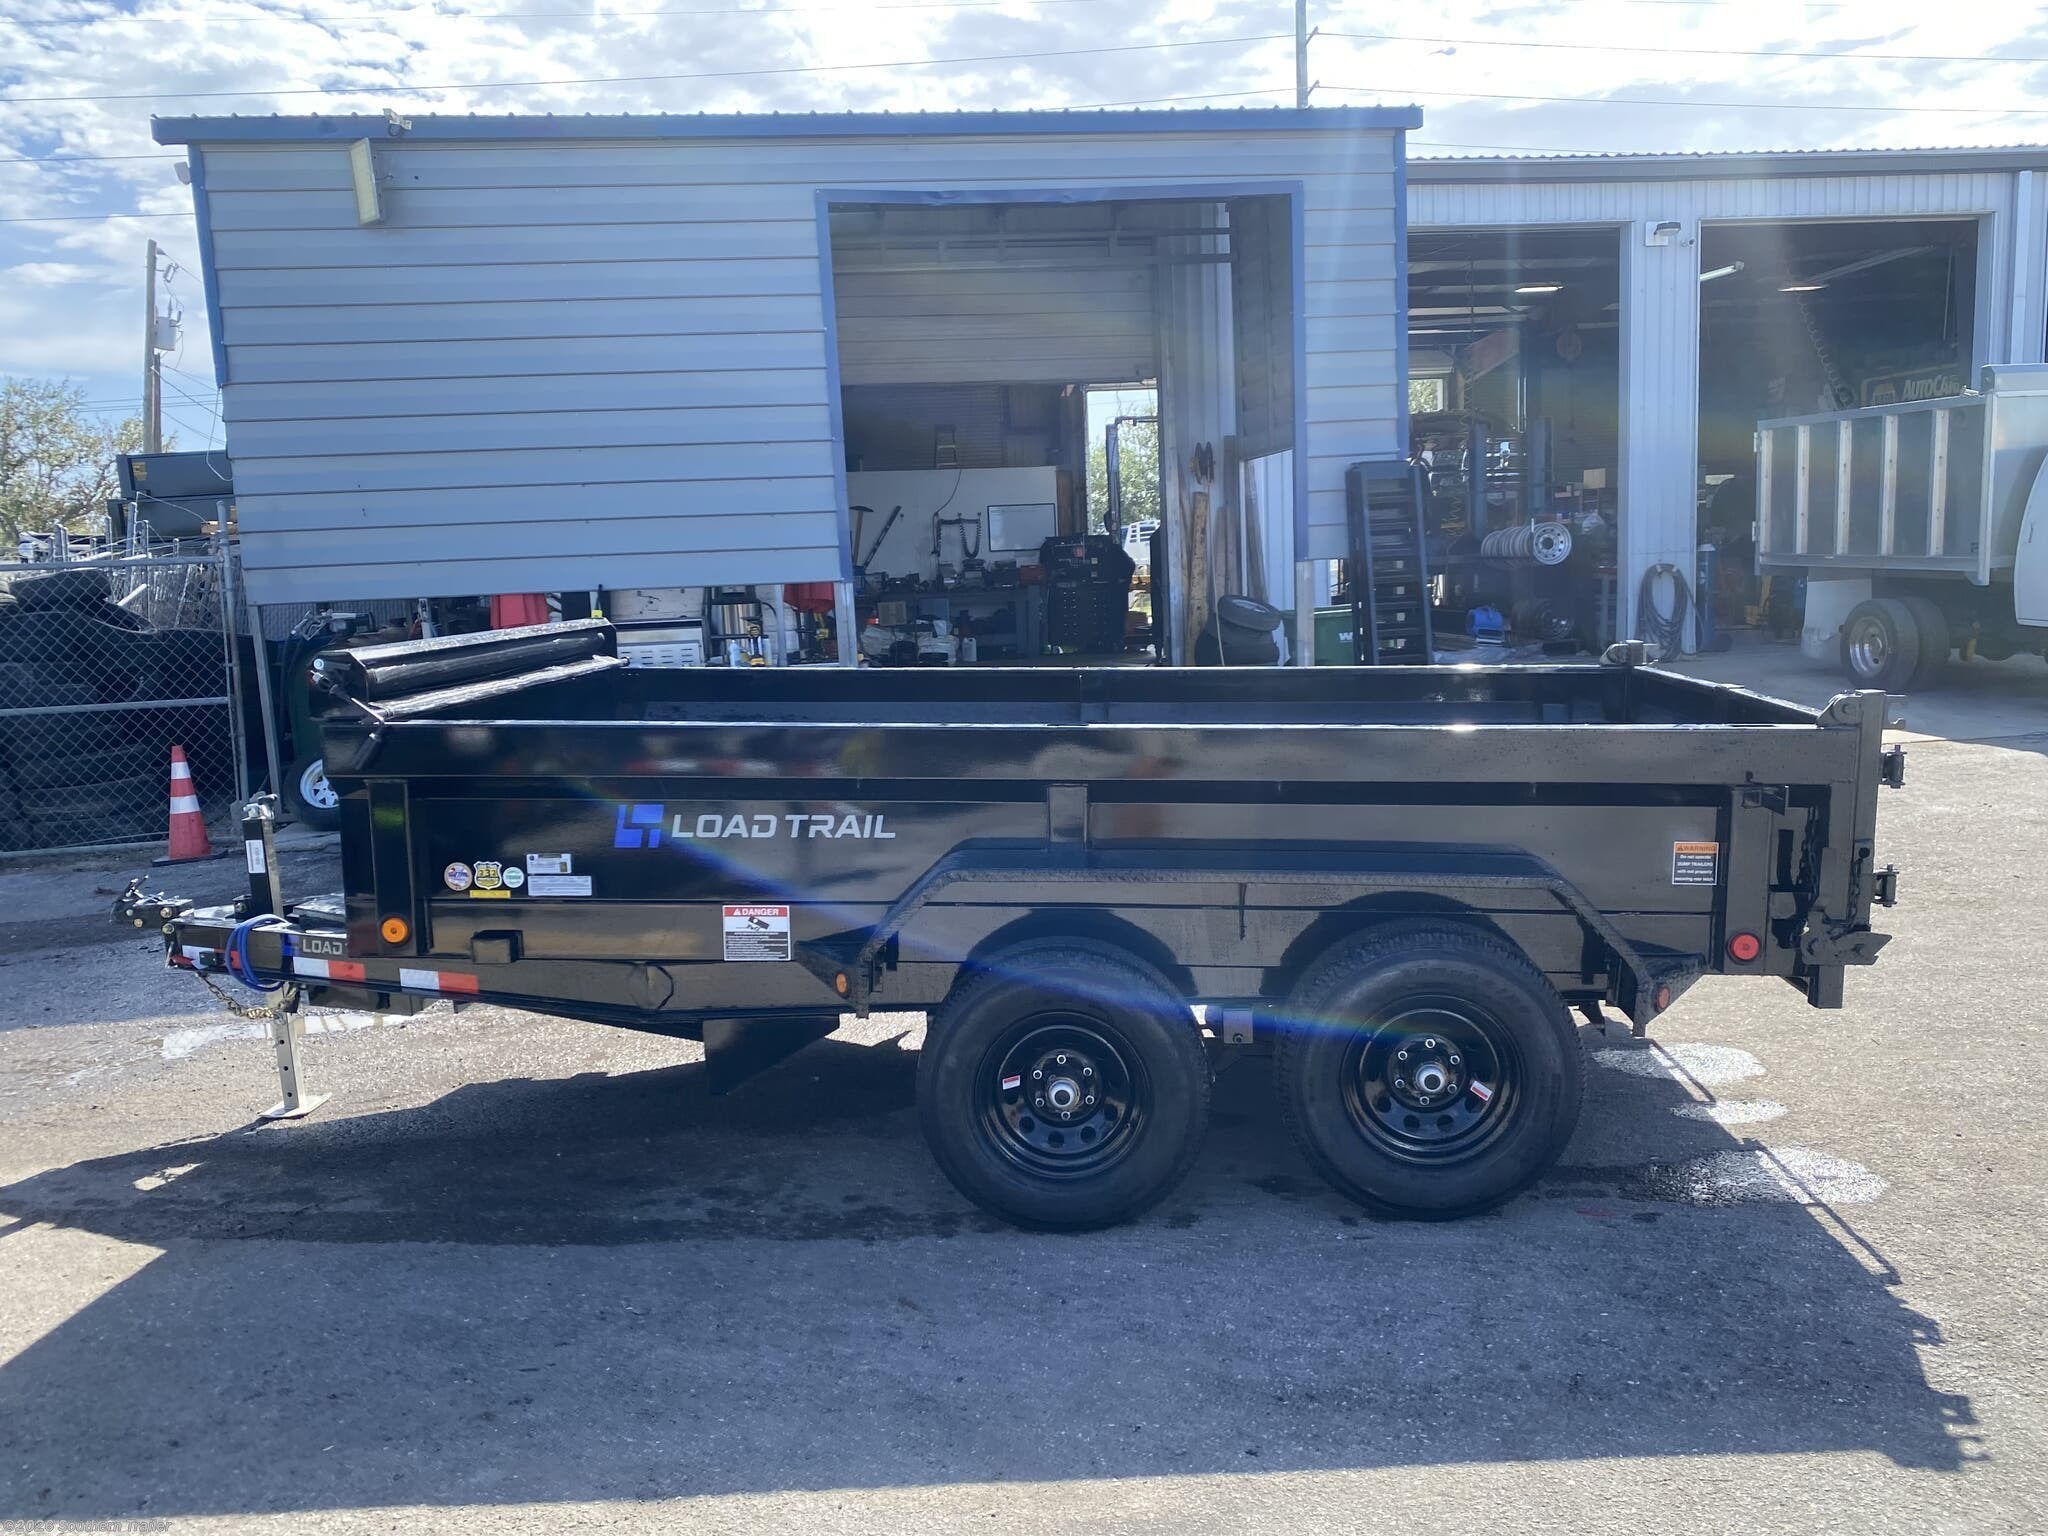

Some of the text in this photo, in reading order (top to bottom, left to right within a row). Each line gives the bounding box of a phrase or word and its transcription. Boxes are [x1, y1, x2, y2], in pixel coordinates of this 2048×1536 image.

[671, 814, 897, 839] LOAD TRAIL
[742, 908, 779, 916] DANGER
[303, 939, 342, 955] LOAD
